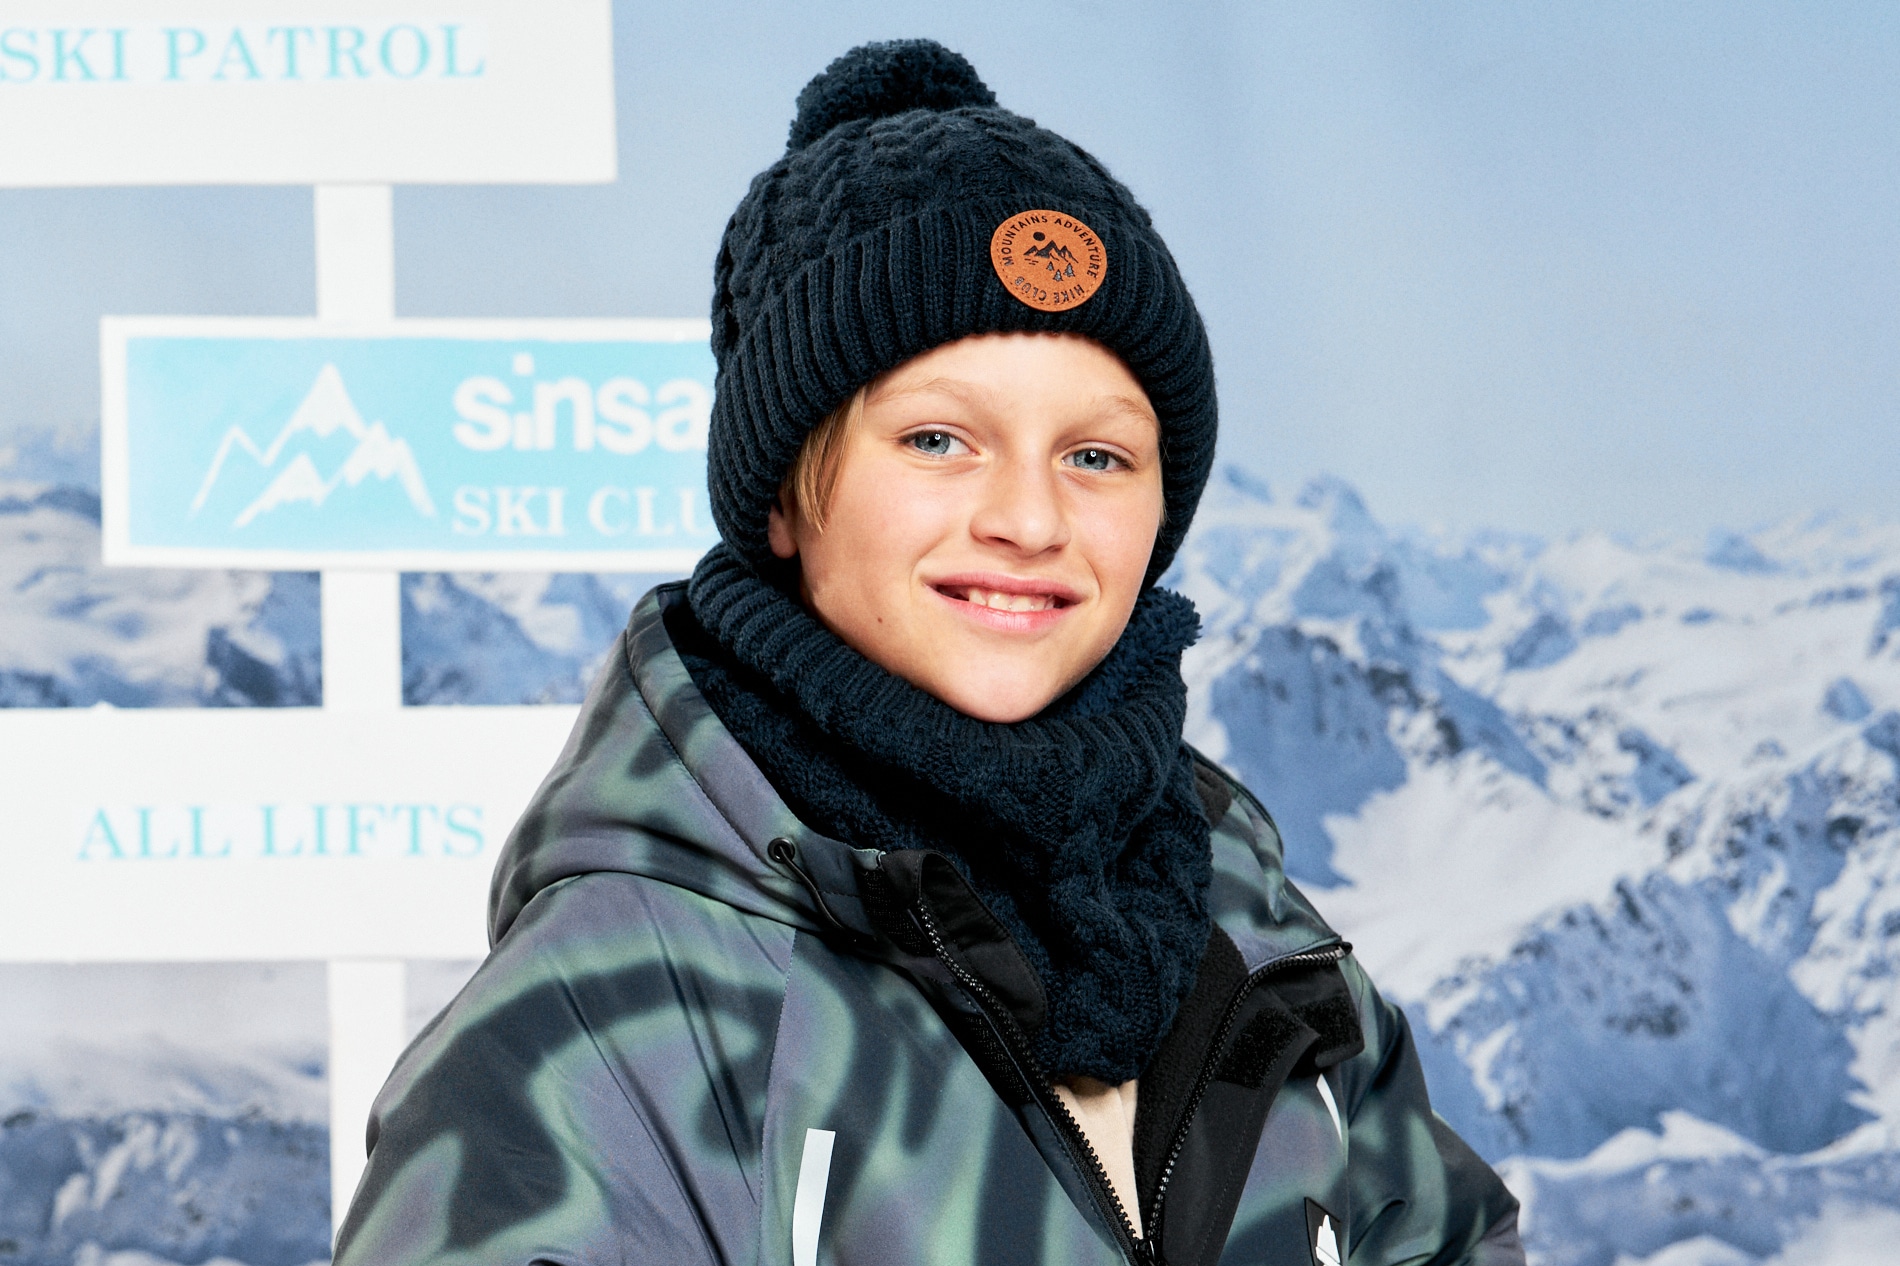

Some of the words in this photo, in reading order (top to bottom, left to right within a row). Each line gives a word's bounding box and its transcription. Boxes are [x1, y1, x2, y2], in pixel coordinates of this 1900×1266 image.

[0, 26, 131, 84] SKI
[161, 23, 487, 82] PATROL
[1001, 215, 1048, 266] MOUNTAINS
[1054, 218, 1100, 279] ADVENTURE
[1014, 276, 1047, 301] CLUB
[1053, 284, 1085, 304] HIKE
[452, 485, 567, 537] SKI
[77, 806, 232, 860] ALL
[258, 803, 486, 858] LIFTS
